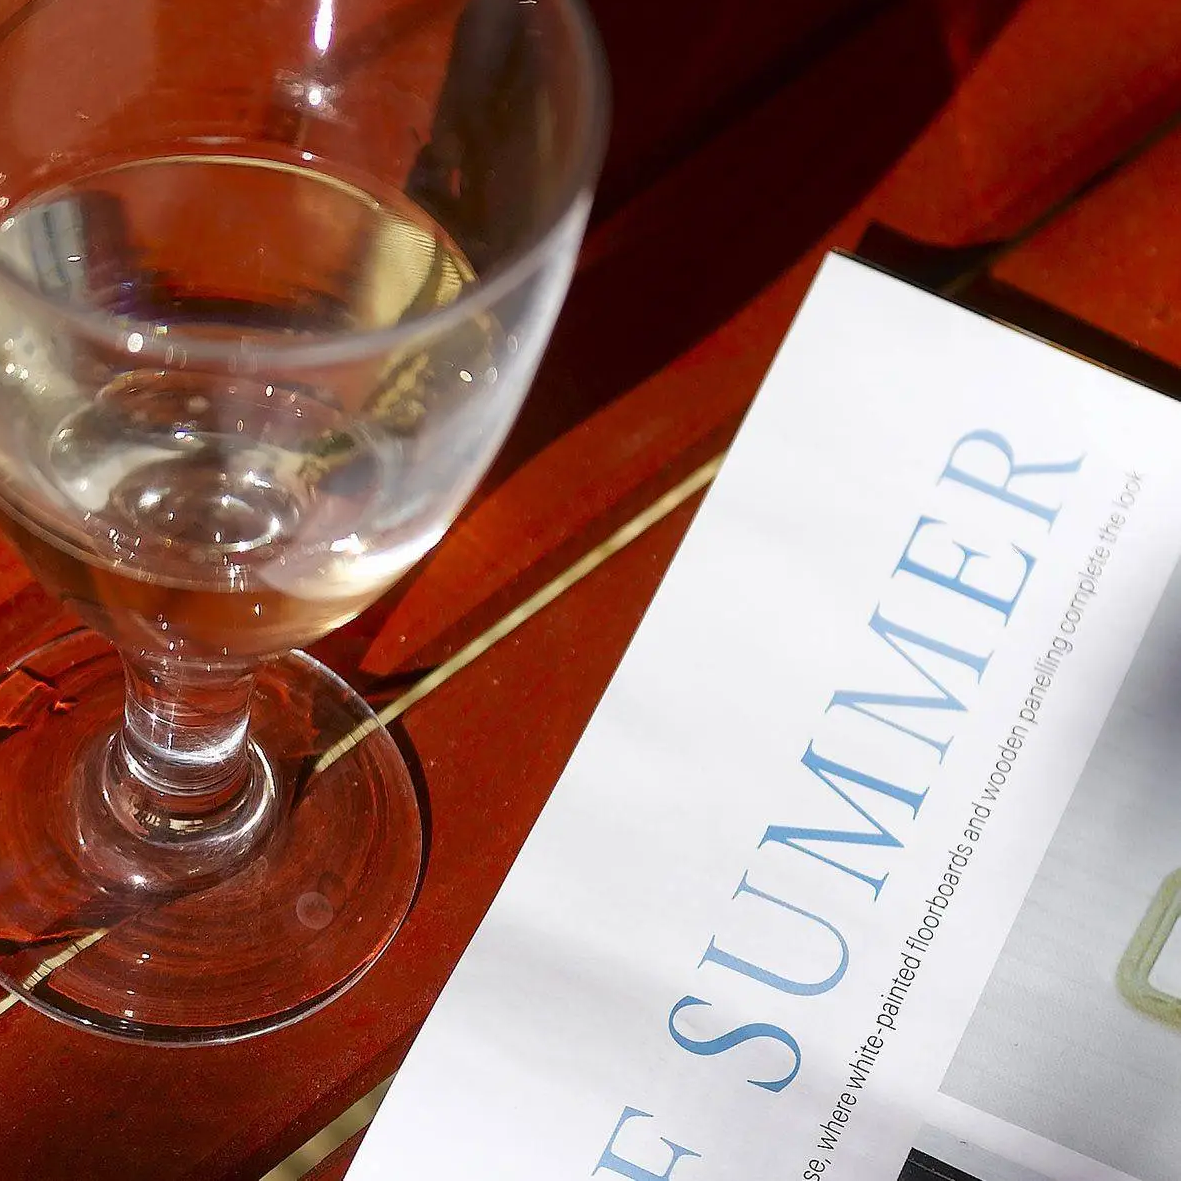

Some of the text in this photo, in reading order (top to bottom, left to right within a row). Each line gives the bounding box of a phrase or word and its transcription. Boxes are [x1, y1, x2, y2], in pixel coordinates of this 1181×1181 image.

[1099, 512, 1127, 544] the
[1112, 469, 1144, 513] look
[1060, 544, 1112, 635] complete
[1019, 635, 1074, 725] panelling
[666, 427, 1086, 1094] SUMMER
[981, 724, 1029, 802] wooden
[963, 800, 992, 843] and
[906, 844, 973, 953] floorboards
[847, 952, 922, 1091] white-painted
[817, 1091, 858, 1151] where
